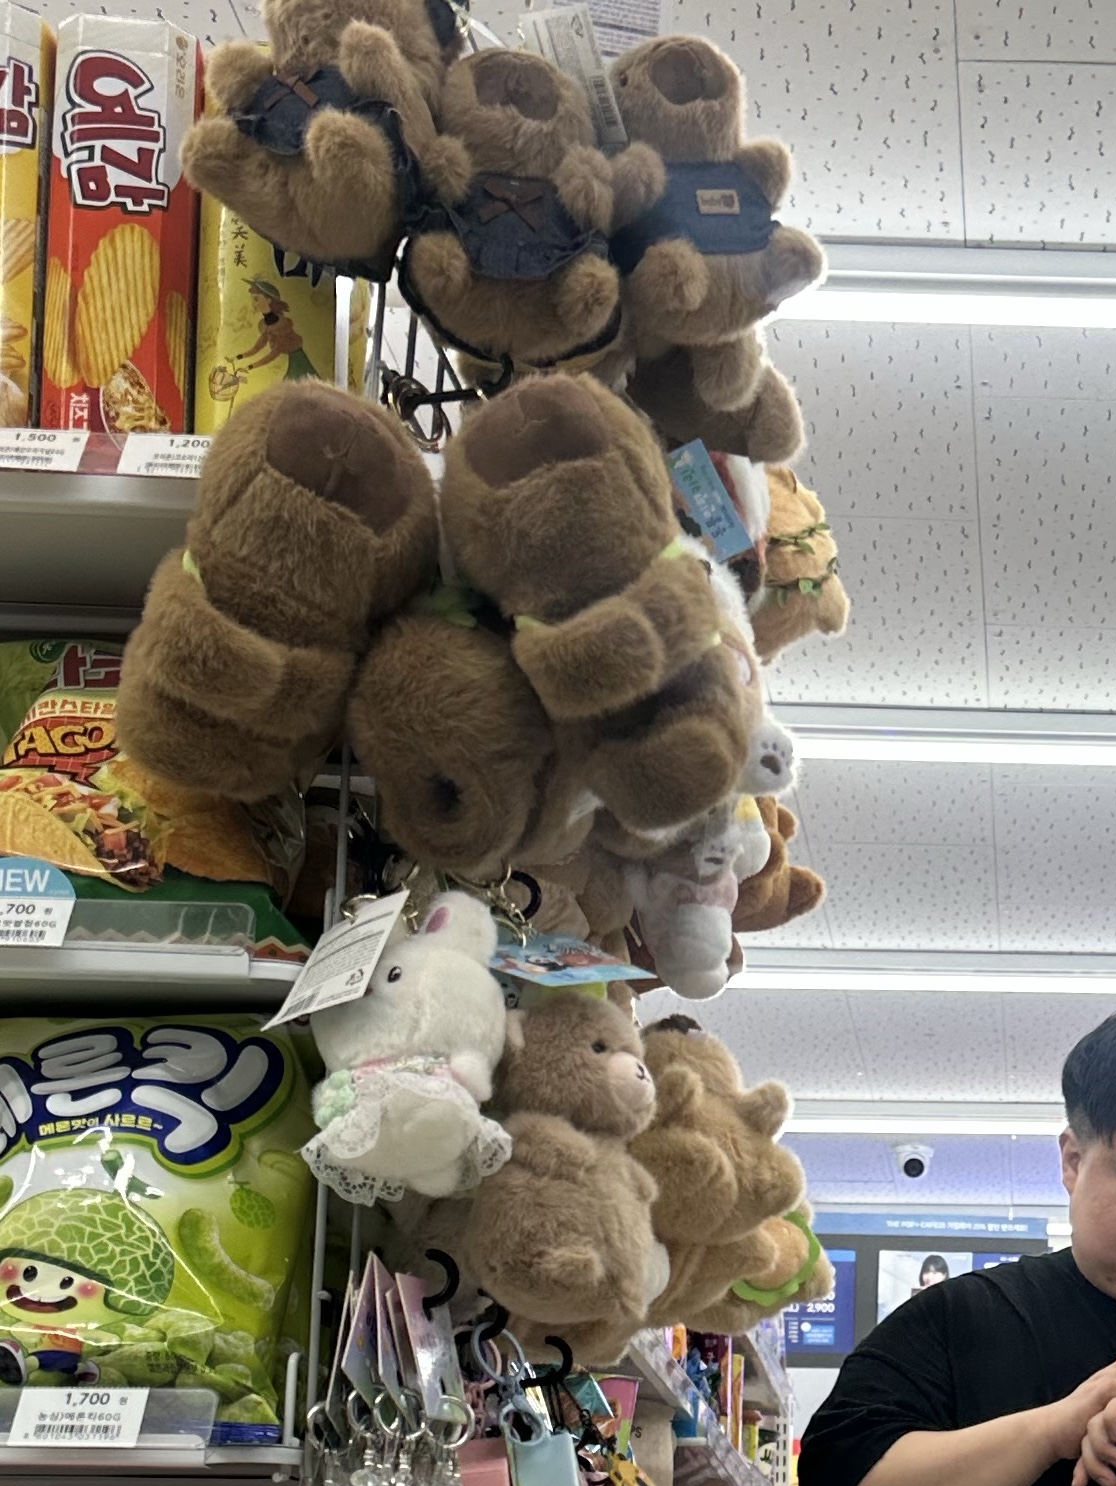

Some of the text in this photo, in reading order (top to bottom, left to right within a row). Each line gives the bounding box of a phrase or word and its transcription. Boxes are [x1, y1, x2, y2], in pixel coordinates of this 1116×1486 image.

[14, 432, 57, 443] 1,500
[169, 438, 211, 449] 1,200
[66, 1393, 111, 1407] 1,700
